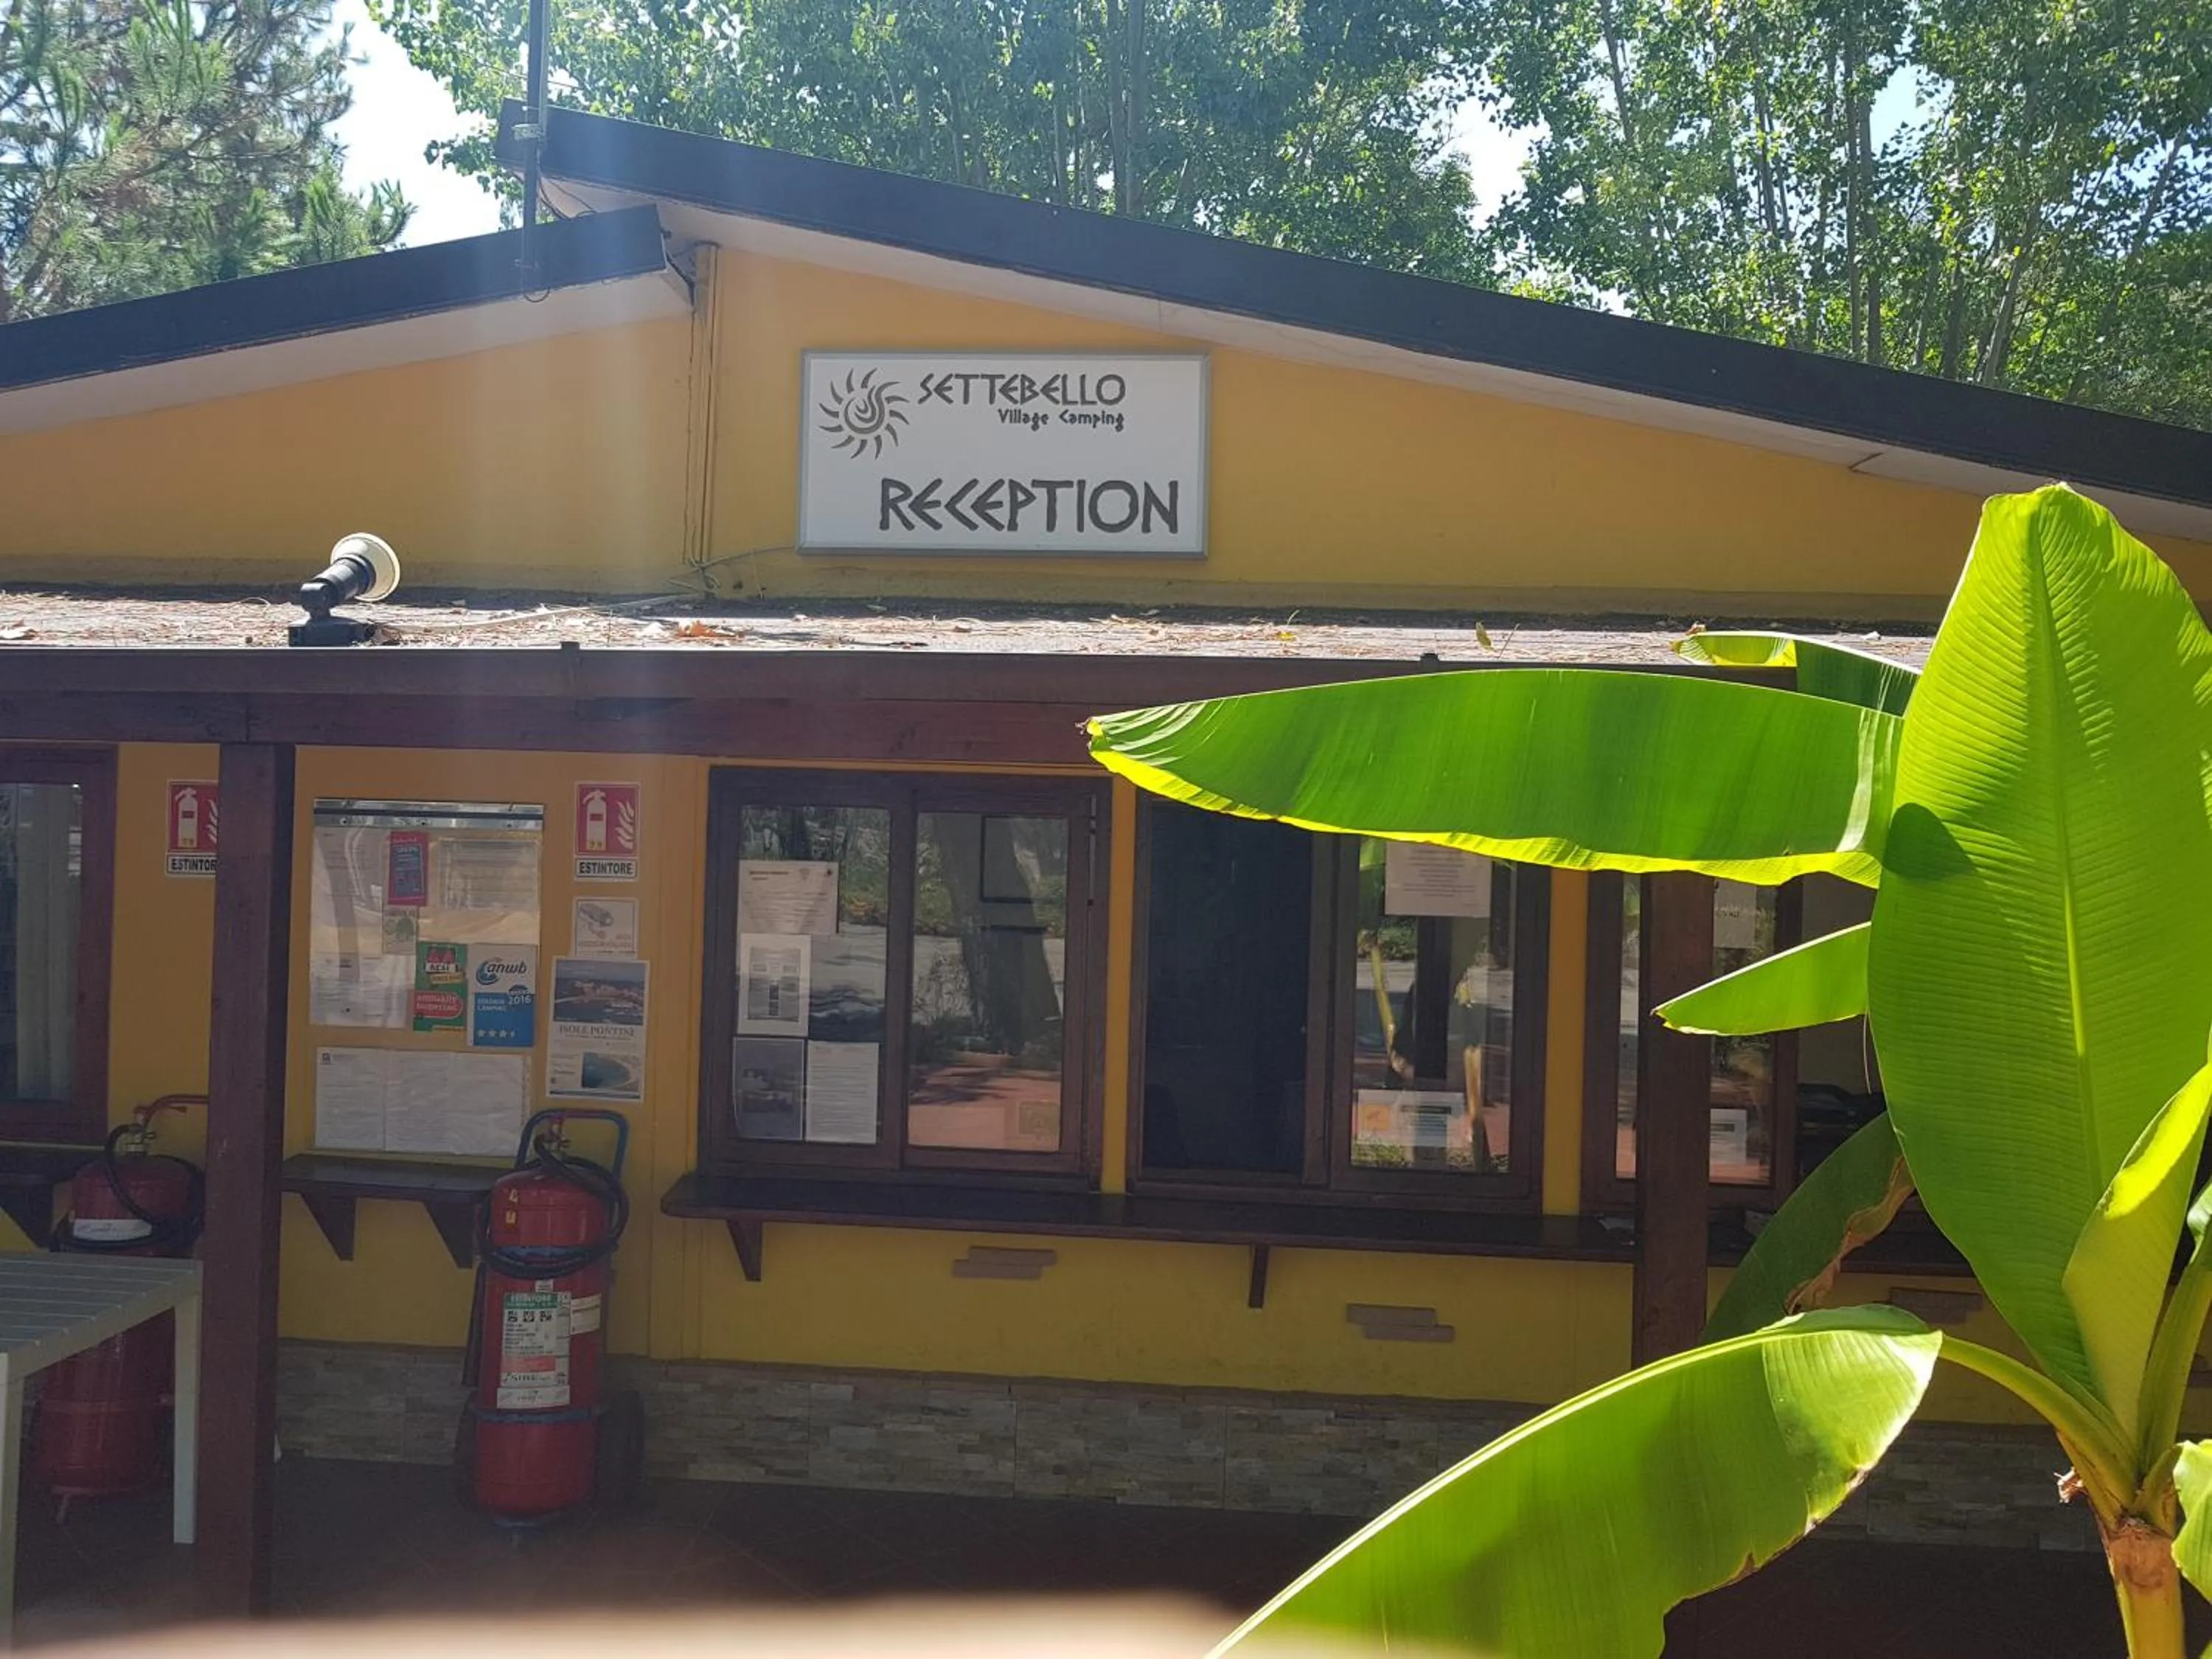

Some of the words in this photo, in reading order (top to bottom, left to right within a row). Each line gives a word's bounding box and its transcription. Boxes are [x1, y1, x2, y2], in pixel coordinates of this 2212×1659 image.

[918, 372, 1126, 406] SETTEBELLO
[998, 408, 1049, 432] Village
[1059, 408, 1125, 433] Camping
[879, 477, 1179, 534] RECEPTION
[171, 858, 217, 871] ESTINTOR
[580, 862, 633, 874] ESTINTORE
[487, 960, 527, 973] anwb
[508, 994, 532, 1006] 2016
